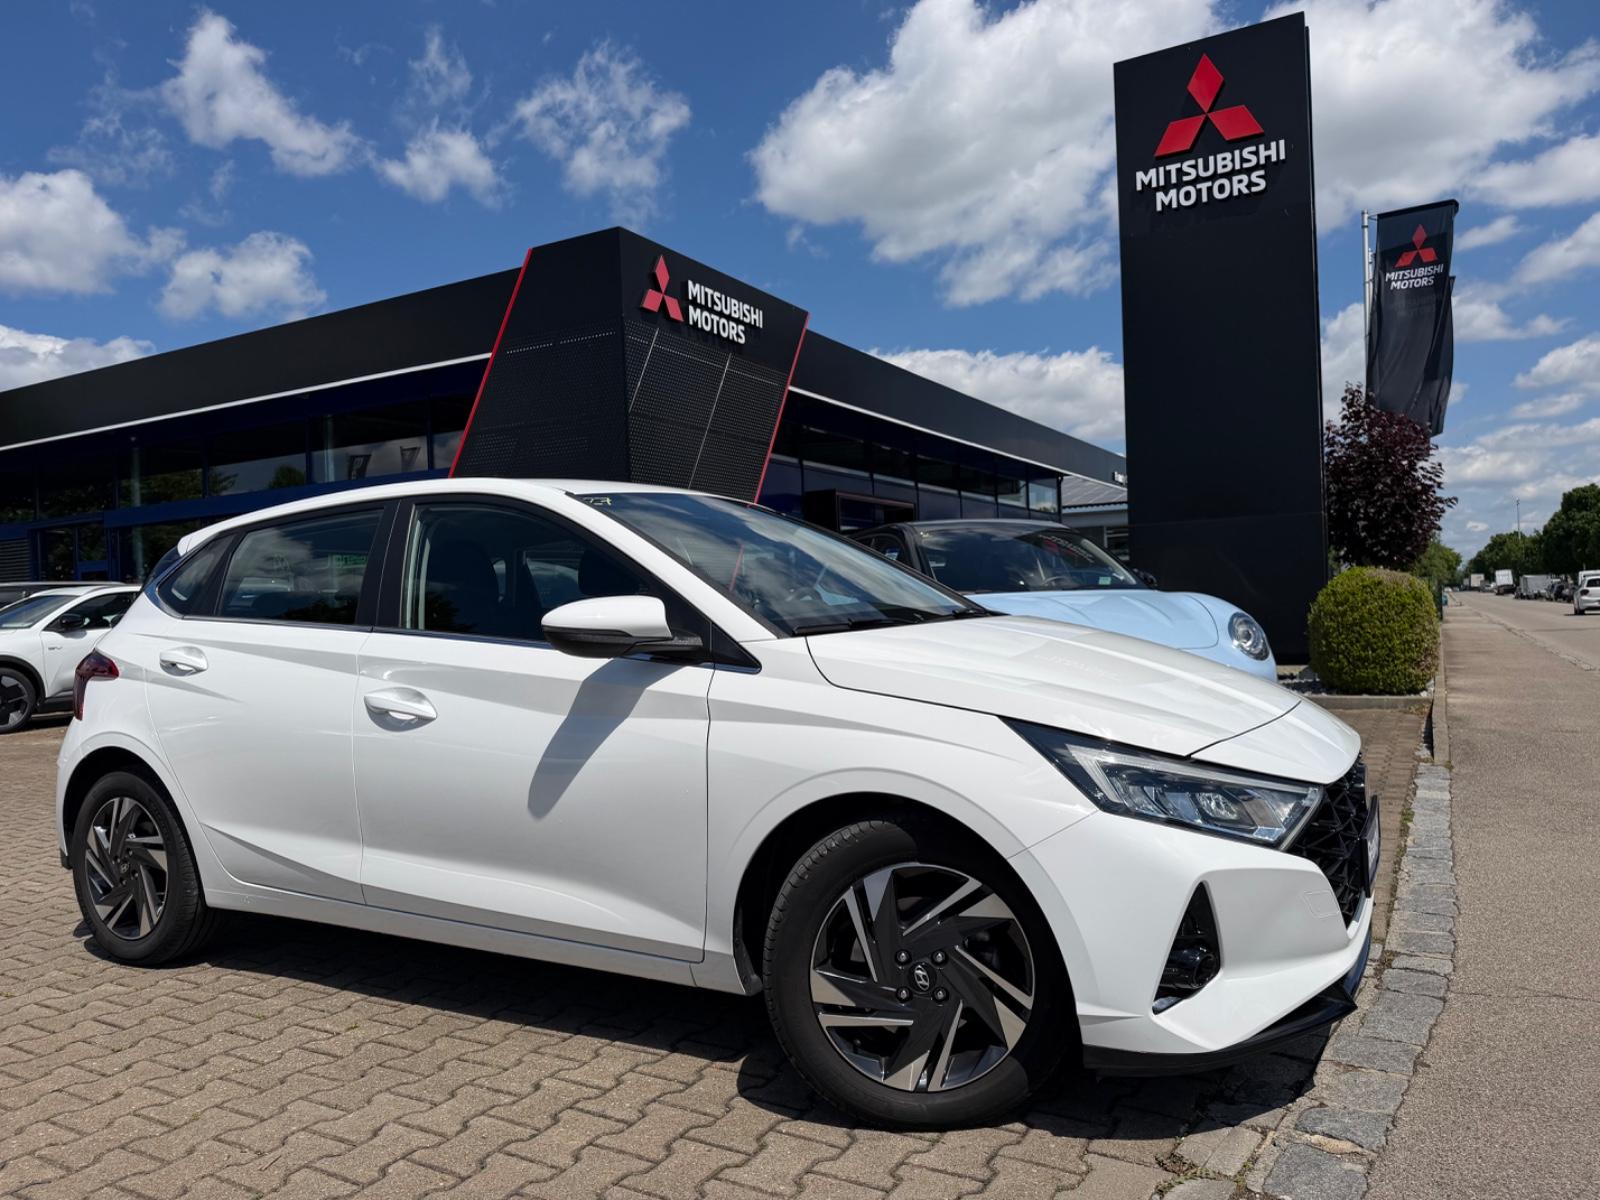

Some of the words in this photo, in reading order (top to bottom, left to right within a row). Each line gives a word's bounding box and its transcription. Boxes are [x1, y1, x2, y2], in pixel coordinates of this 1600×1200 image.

[1135, 139, 1286, 192] MITSUBISHI
[1155, 169, 1267, 212] MOTORS
[1385, 263, 1444, 282] MITSUBISHI
[1390, 275, 1435, 291] MOTORS
[687, 279, 763, 329] MITSUBISHI
[688, 304, 746, 345] MOTORS
